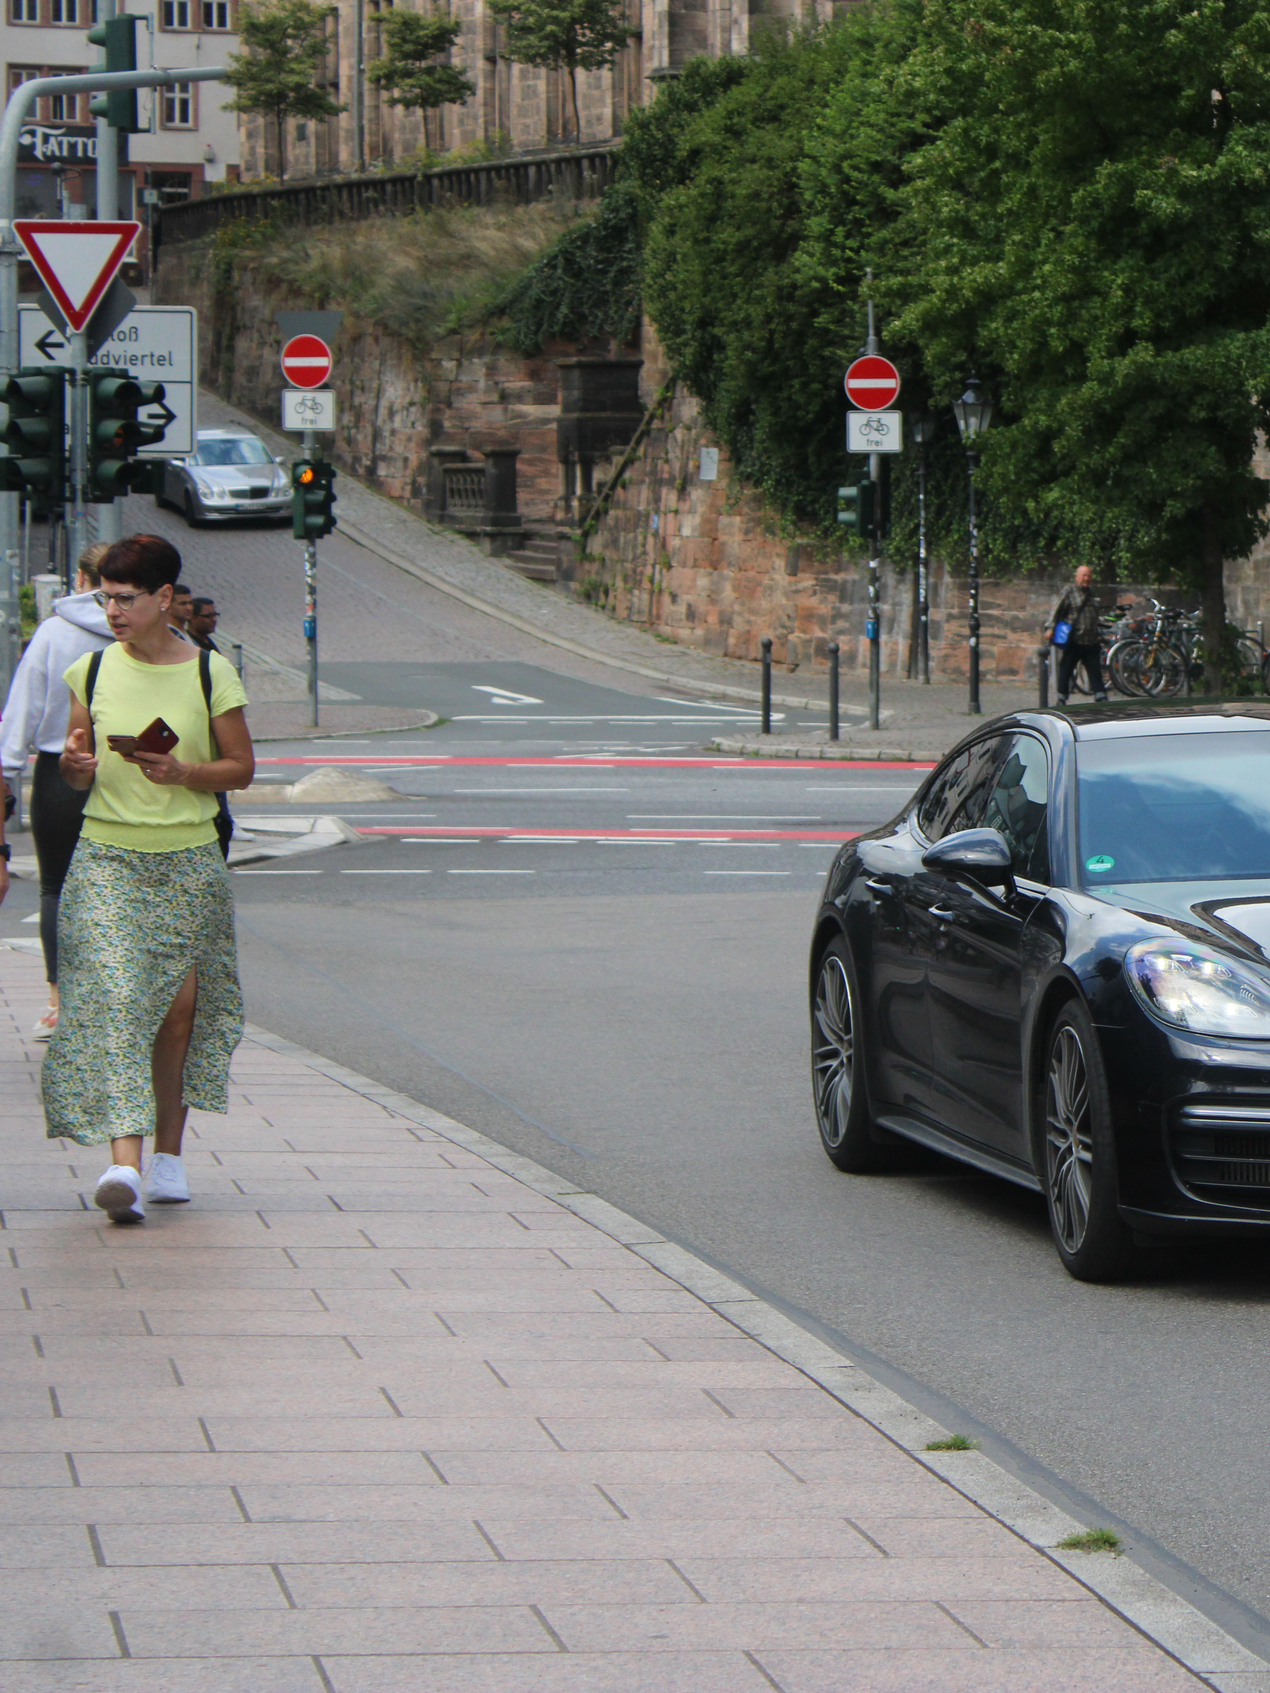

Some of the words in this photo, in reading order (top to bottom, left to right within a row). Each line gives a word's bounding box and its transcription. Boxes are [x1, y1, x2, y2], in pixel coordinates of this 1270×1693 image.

[18, 125, 98, 161] TATTO
[301, 416, 317, 425] frei
[866, 438, 883, 447] frei
